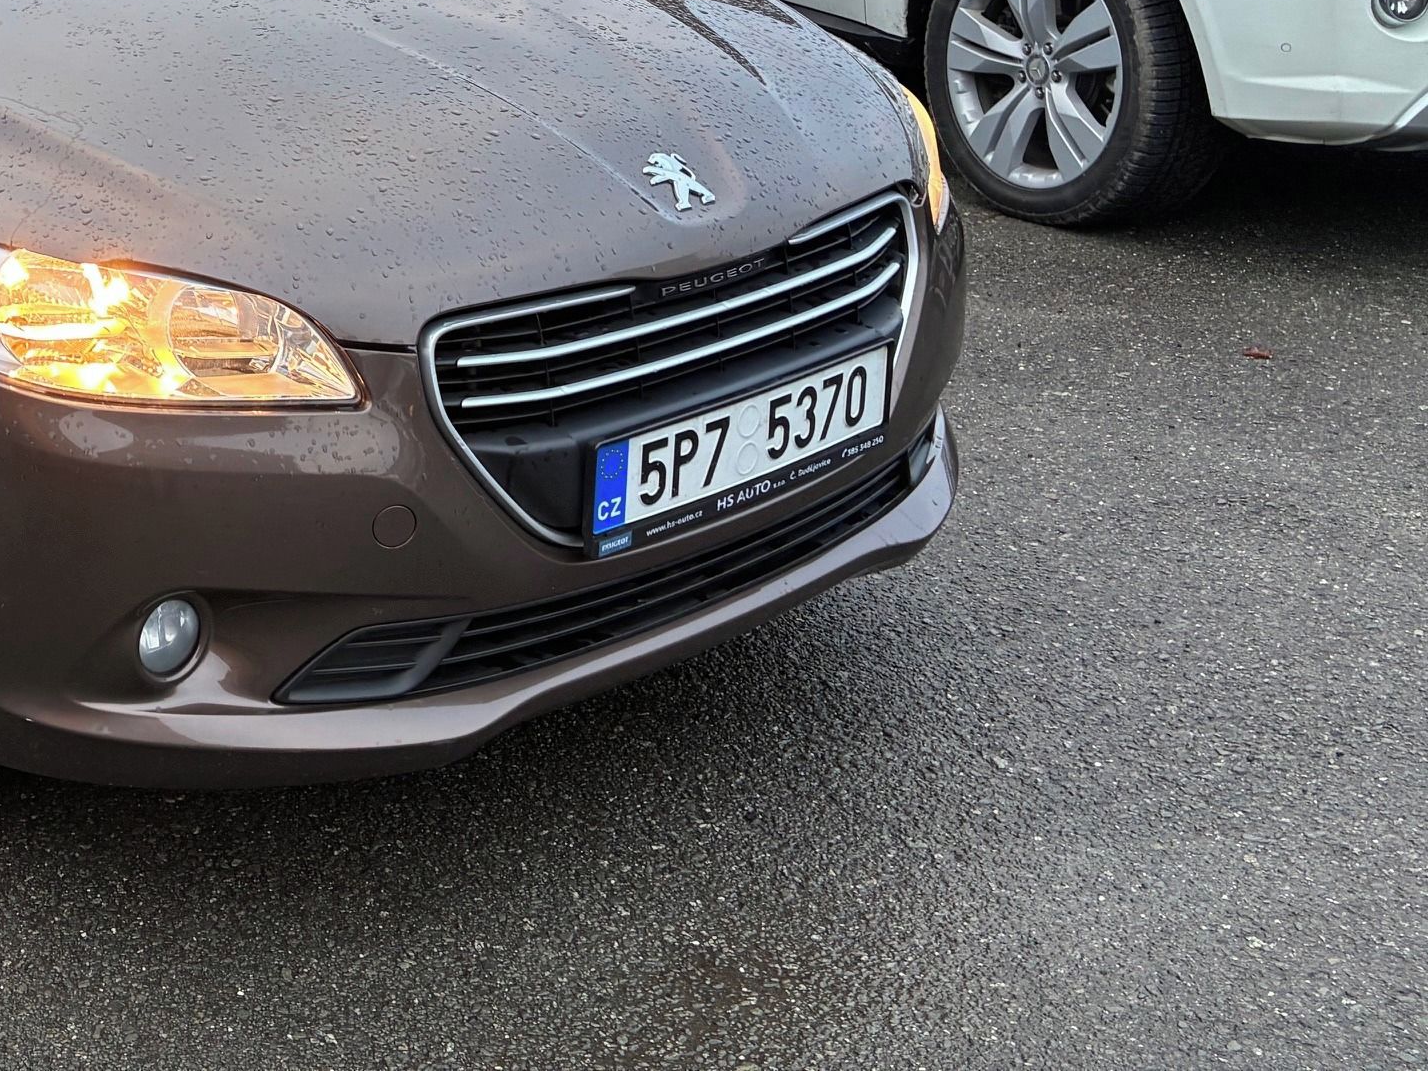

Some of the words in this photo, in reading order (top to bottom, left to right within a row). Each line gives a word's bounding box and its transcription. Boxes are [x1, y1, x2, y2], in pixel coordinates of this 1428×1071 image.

[661, 258, 765, 297] PEUGEOT
[639, 416, 732, 506] 5P7
[766, 365, 867, 459] 5370
[597, 496, 622, 521] CZ
[646, 510, 703, 537] www.hs-auto.cz
[717, 494, 734, 511] HS
[736, 480, 771, 504] AUTO
